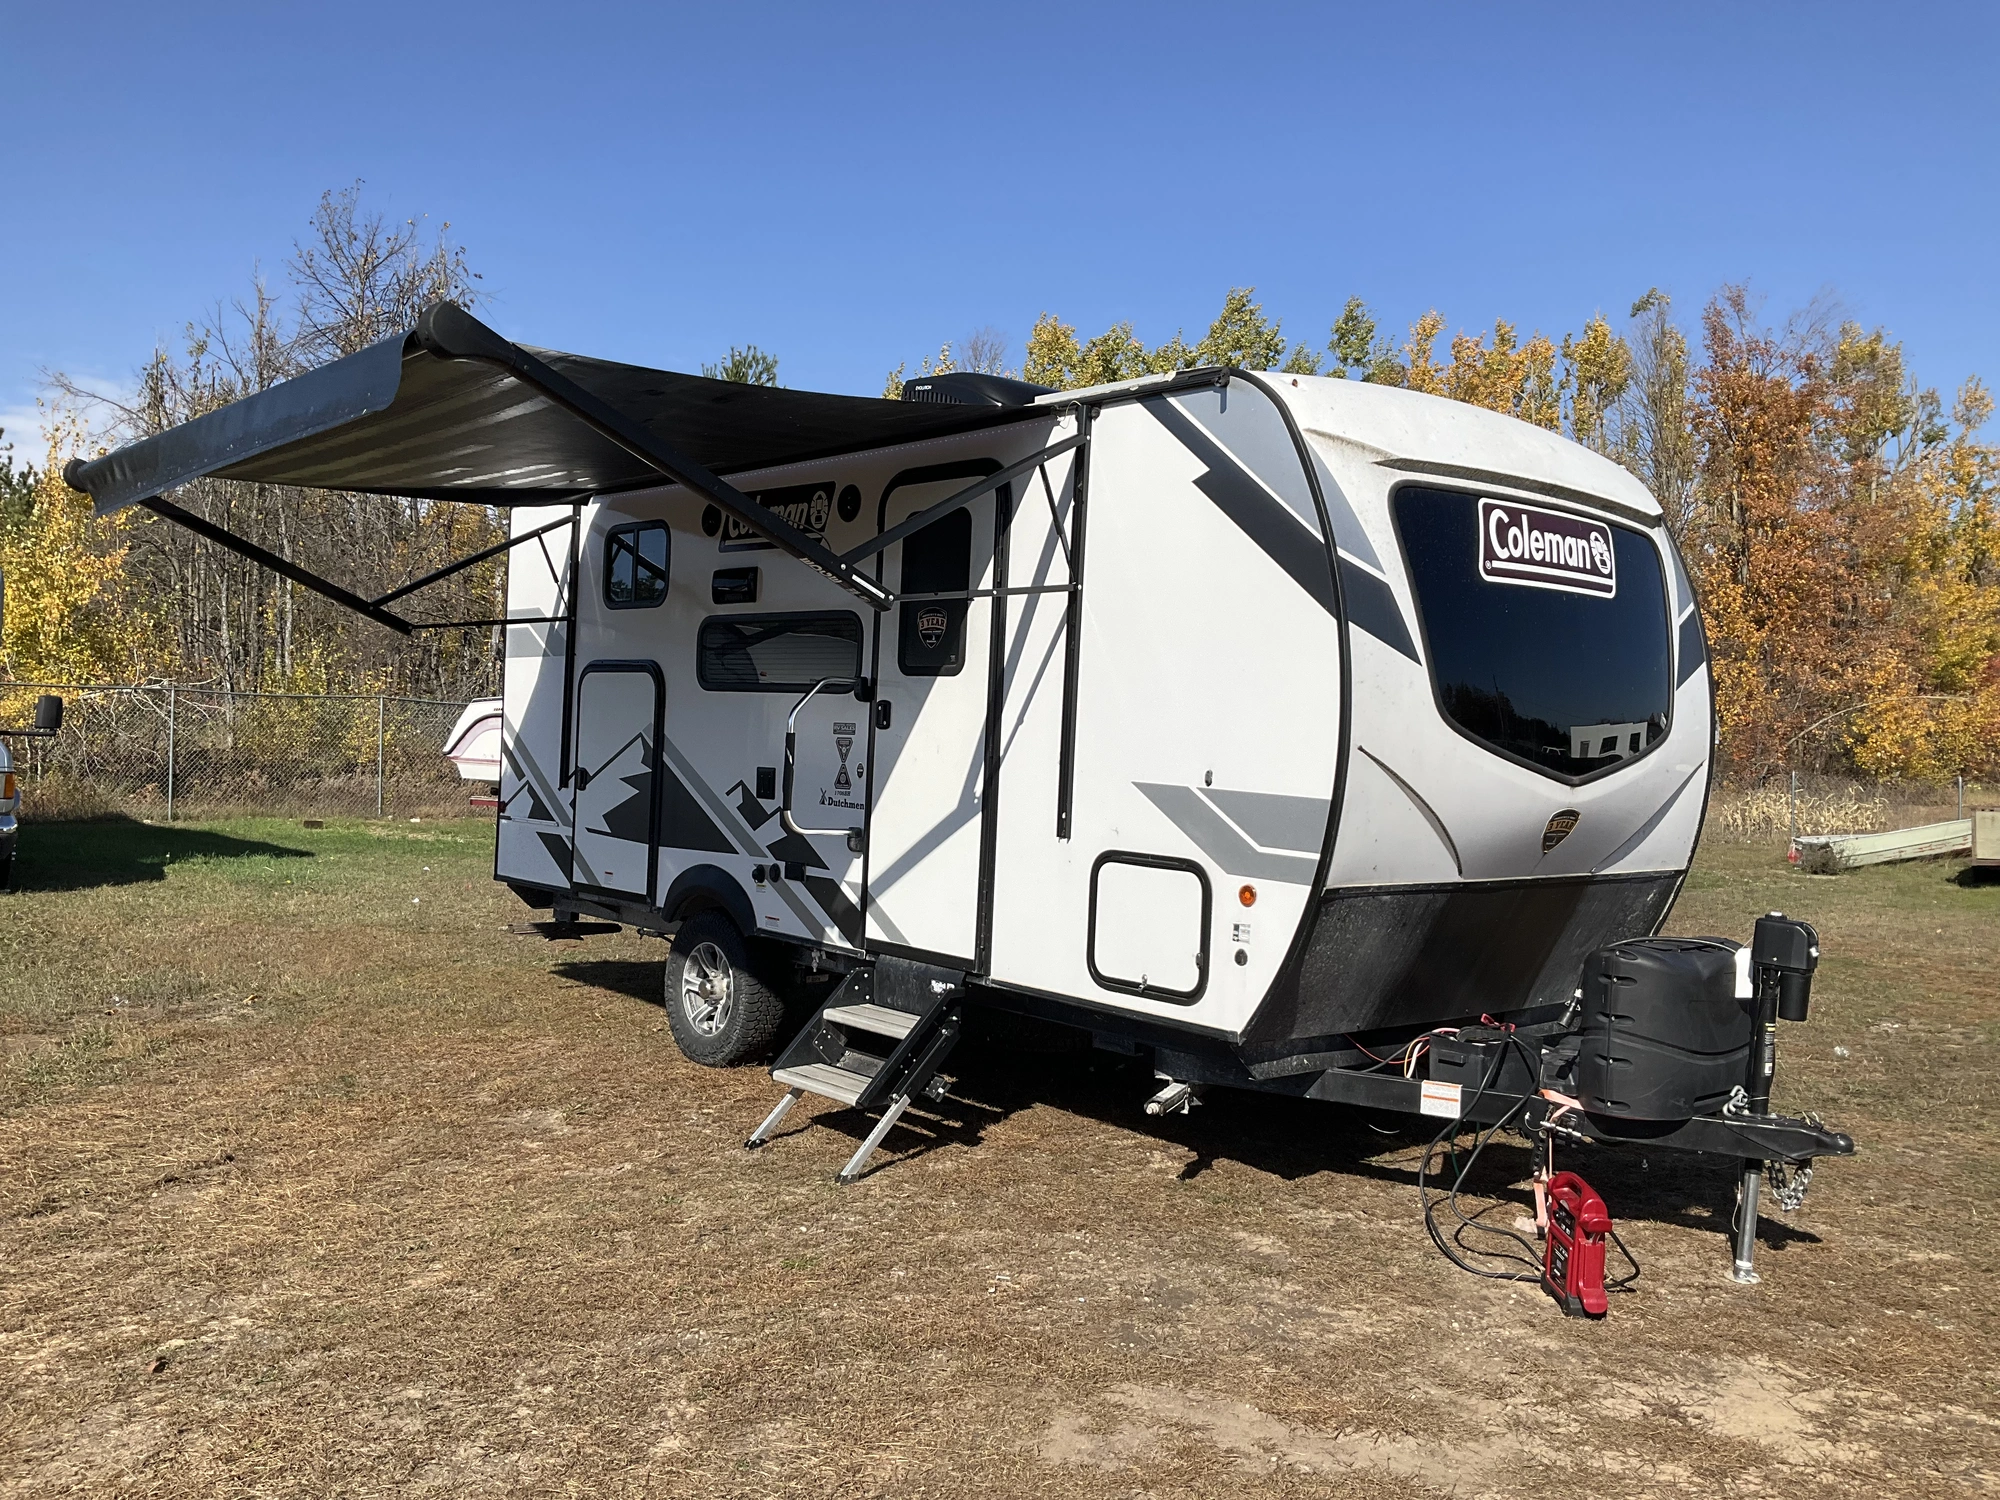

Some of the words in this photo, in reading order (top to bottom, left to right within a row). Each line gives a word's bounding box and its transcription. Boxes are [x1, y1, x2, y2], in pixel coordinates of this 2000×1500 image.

[727, 494, 809, 538] Cman
[1489, 508, 1591, 570] Coleman
[926, 617, 946, 627] YEAR
[827, 796, 865, 810] Dutchmen
[1555, 820, 1576, 831] YEAR
